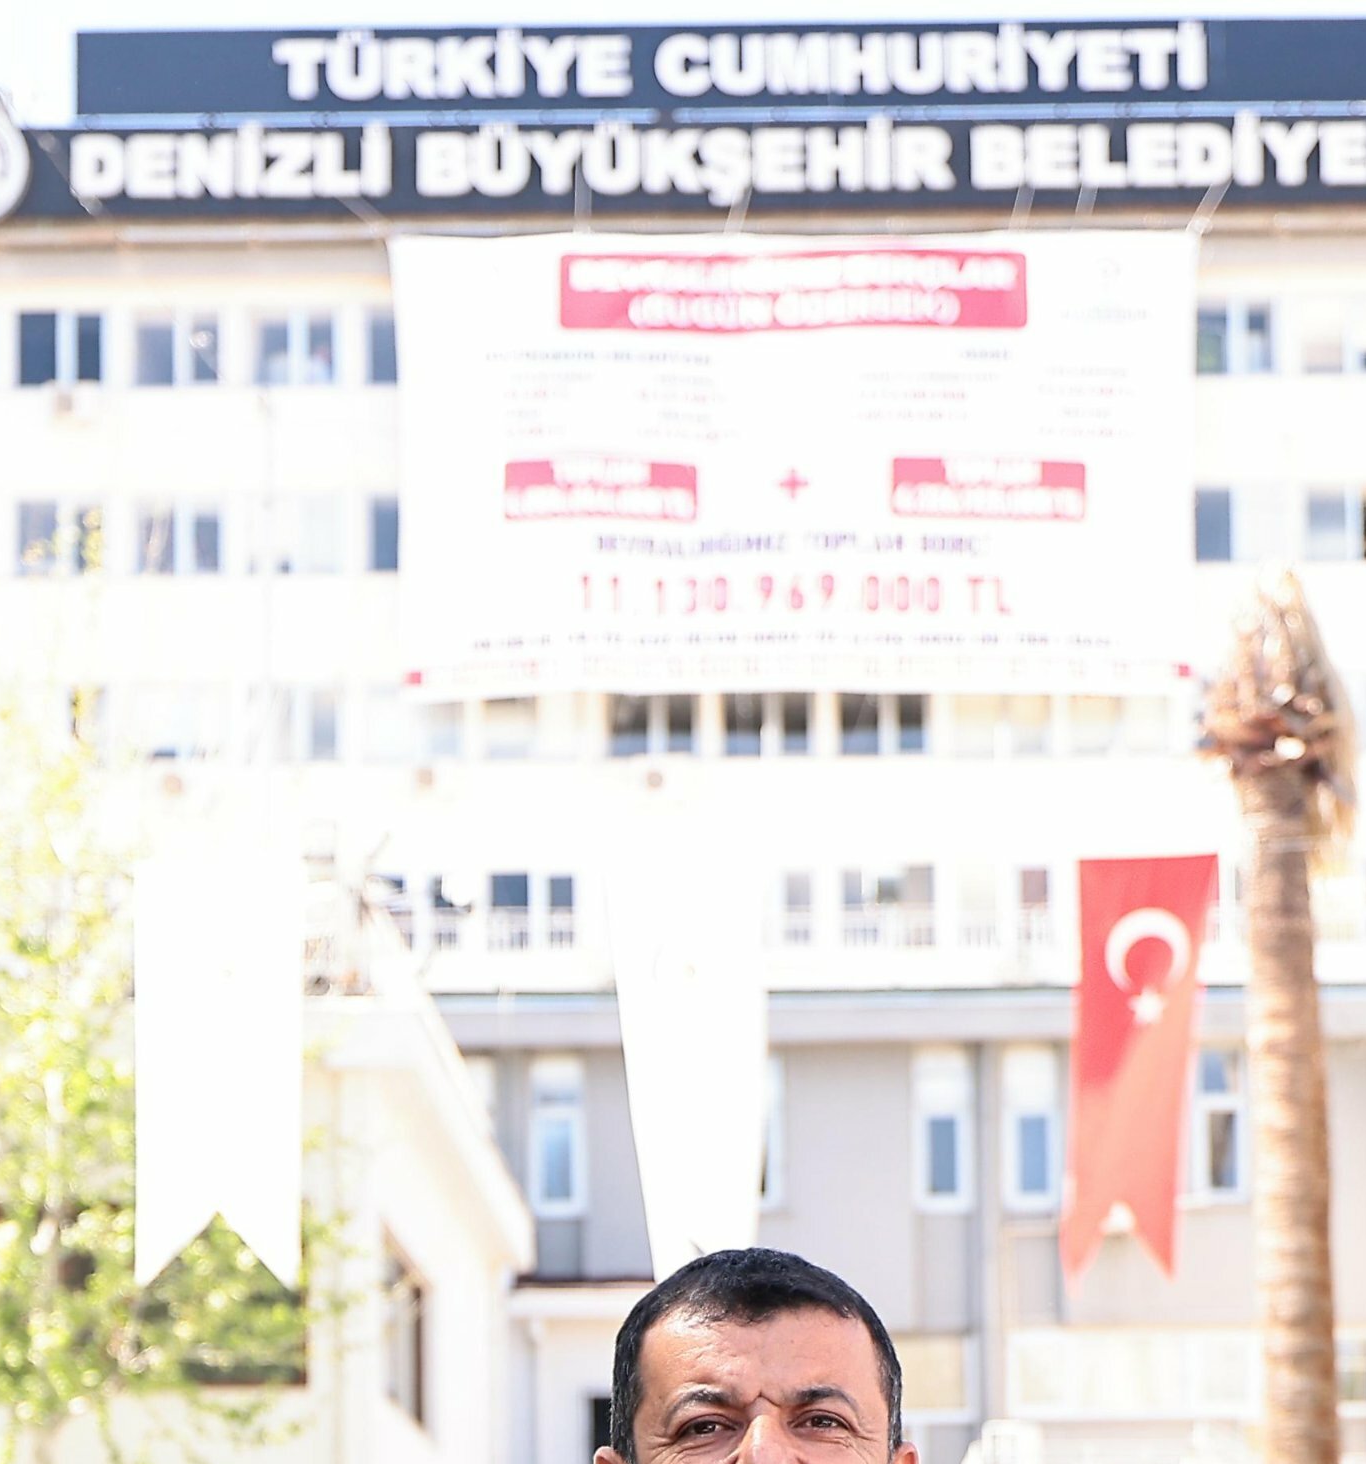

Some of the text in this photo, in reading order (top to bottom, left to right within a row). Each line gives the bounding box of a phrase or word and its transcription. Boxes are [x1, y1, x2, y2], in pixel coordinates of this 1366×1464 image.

[270, 23, 1208, 101] TÜRKİYE CUMHURİYETİ
[69, 121, 393, 199] DENİZLİ
[416, 118, 954, 206] BÜYÜKŞEHİR
[967, 575, 1013, 616] TL
